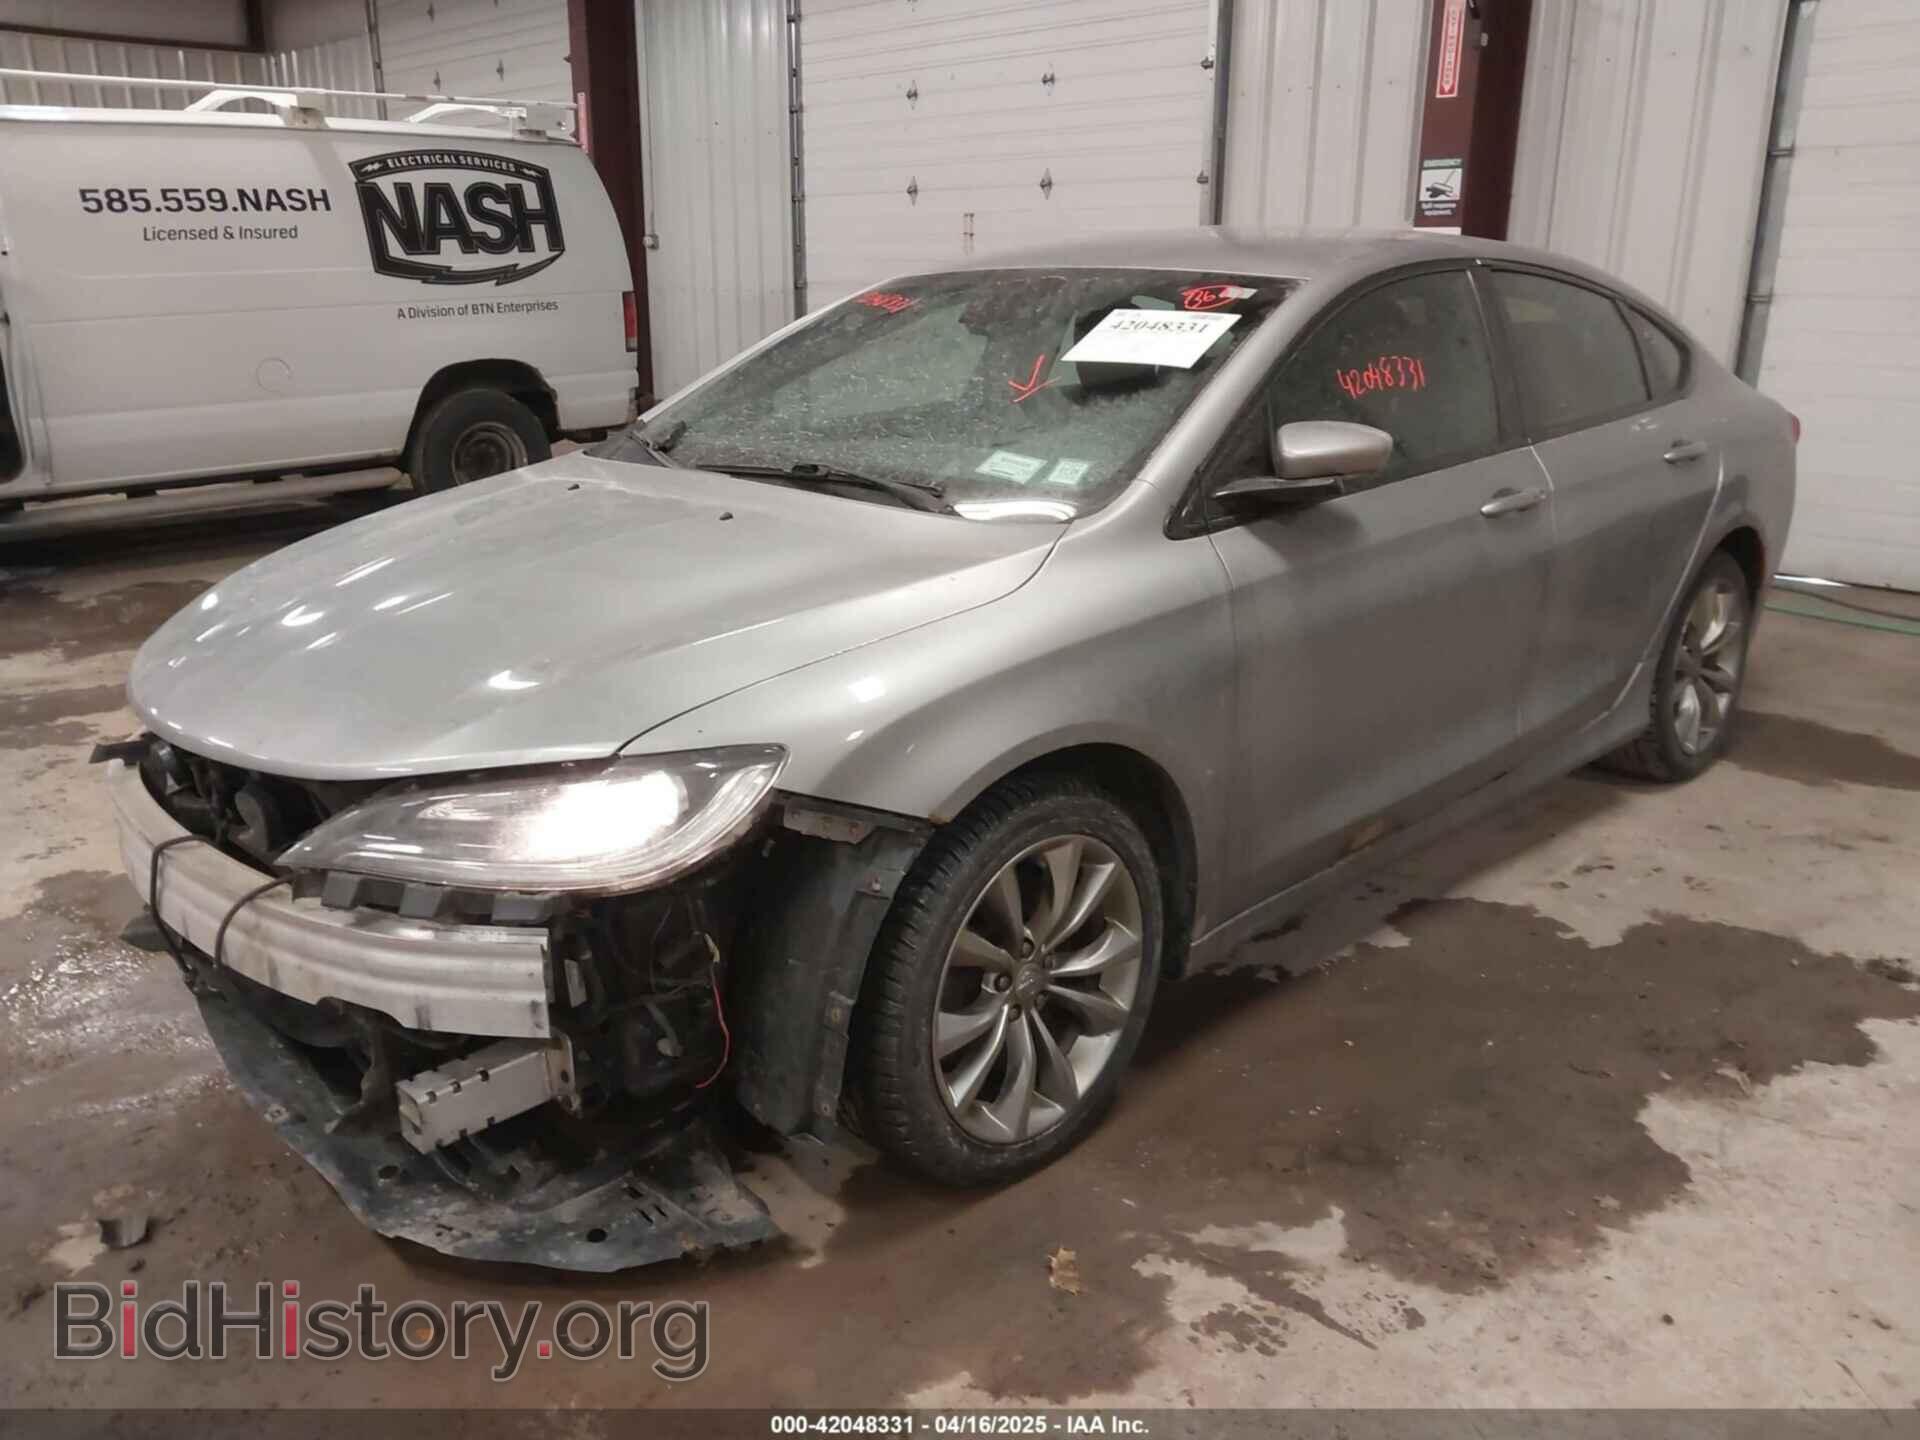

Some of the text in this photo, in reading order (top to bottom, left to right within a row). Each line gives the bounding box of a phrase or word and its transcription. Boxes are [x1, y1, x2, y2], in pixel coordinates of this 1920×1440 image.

[386, 154, 516, 172] ELECTRICAL SERVICES
[80, 188, 332, 213] 585.559.NASH
[355, 181, 565, 255] NASH
[143, 225, 298, 241] Licensed & Insured
[397, 300, 559, 319] A Division of BTN Enterprises
[1111, 319, 1211, 334] 42048331
[1336, 355, 1425, 400] 42048331
